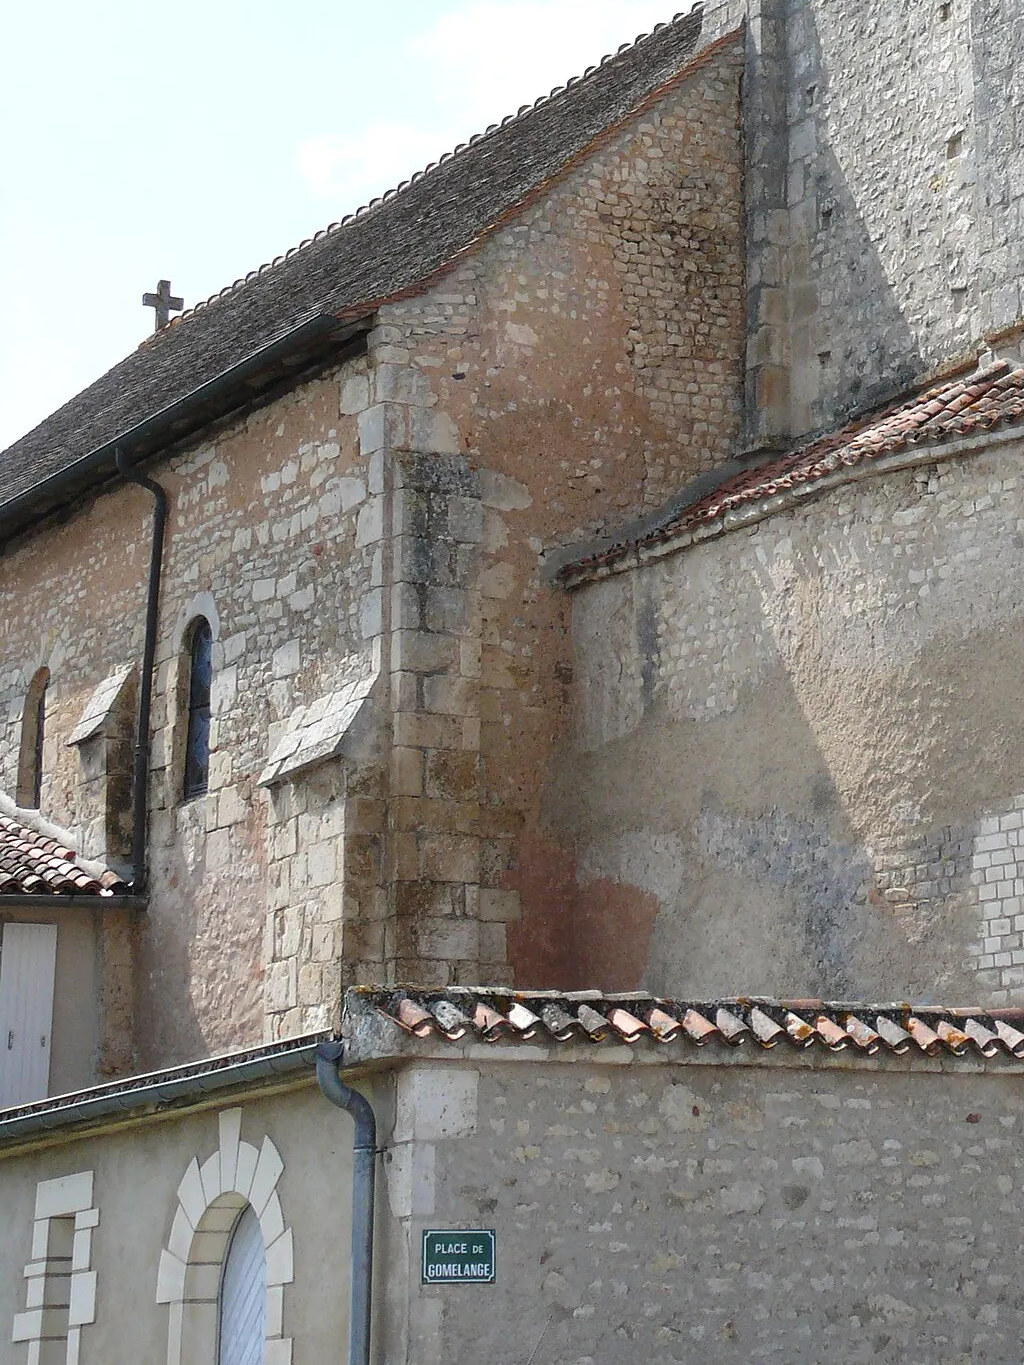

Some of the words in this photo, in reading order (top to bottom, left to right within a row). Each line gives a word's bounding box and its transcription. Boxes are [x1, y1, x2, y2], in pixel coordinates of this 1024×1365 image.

[435, 1243, 468, 1254] PLACE
[472, 1245, 484, 1254] DE
[428, 1263, 490, 1277] GOMELANGE
